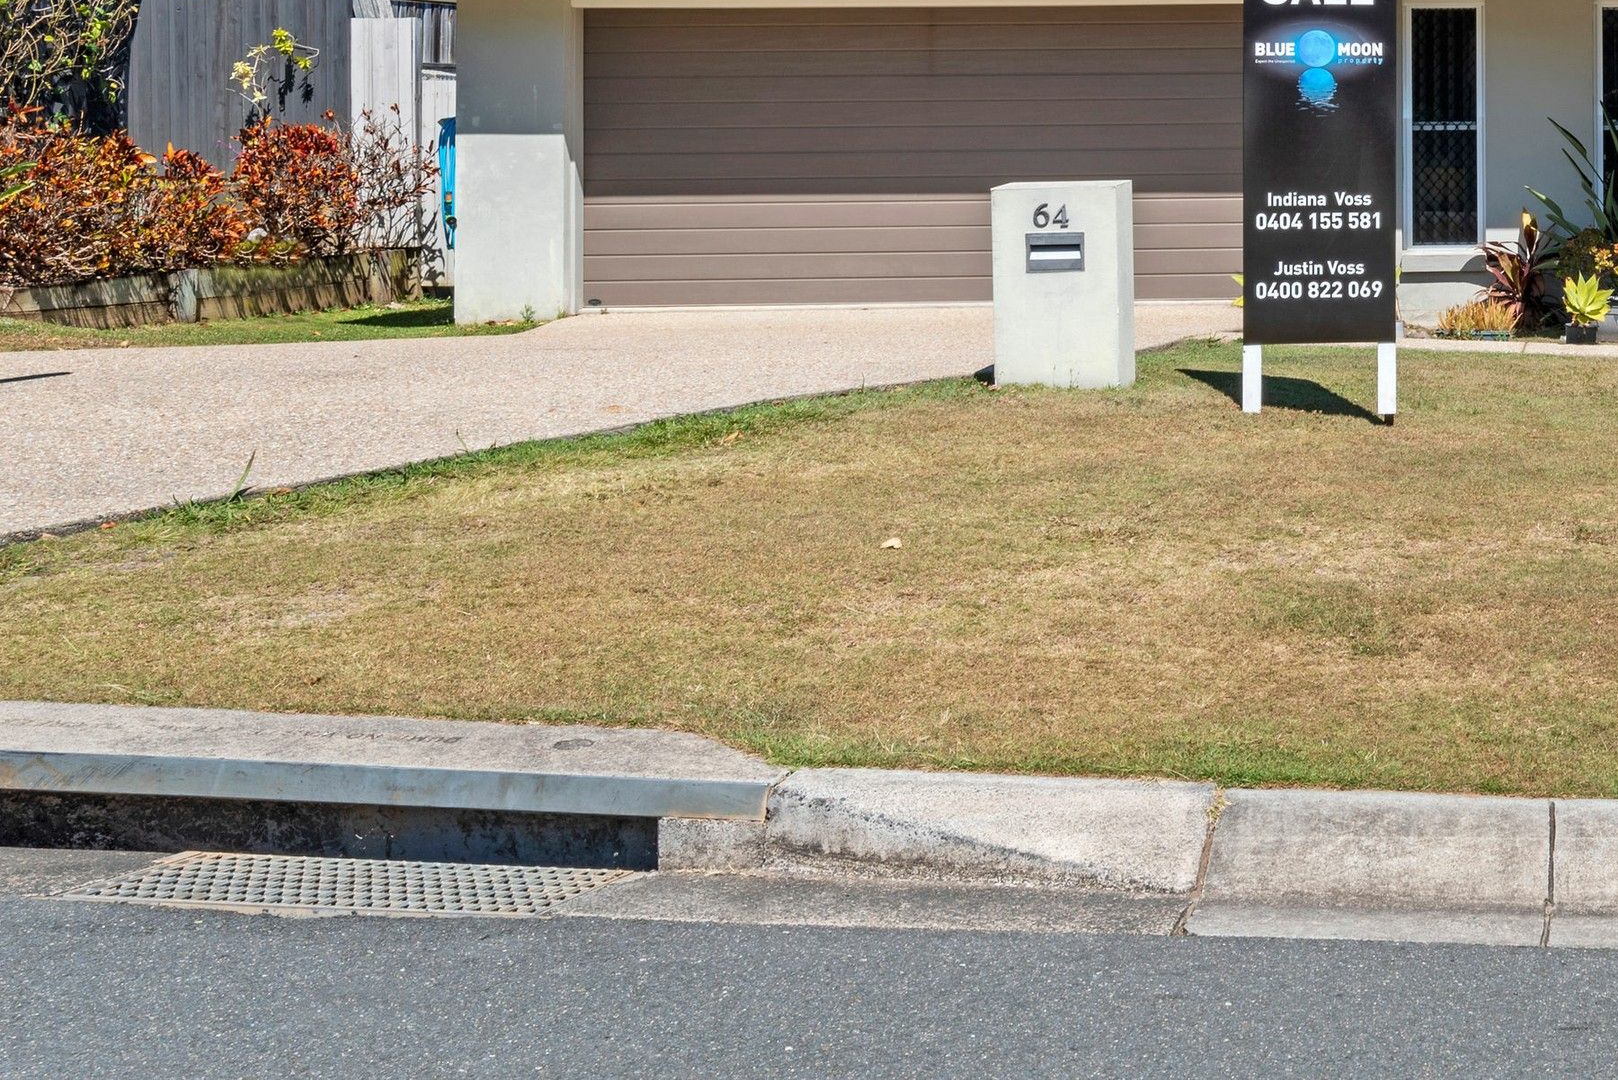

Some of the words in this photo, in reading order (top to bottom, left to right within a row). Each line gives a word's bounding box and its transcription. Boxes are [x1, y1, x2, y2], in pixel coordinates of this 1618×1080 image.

[1254, 41, 1296, 57] BLUE
[1337, 41, 1383, 57] MOON
[1266, 191, 1327, 207] Indiana
[1333, 191, 1373, 206] Voss
[1032, 202, 1070, 230] 64
[1255, 212, 1303, 231] 0404
[1308, 211, 1344, 230] 155
[1347, 210, 1382, 230] 581
[1273, 260, 1324, 276] Justin
[1326, 259, 1365, 275] Voss
[1255, 281, 1303, 300] 0400
[1307, 280, 1343, 299] 822
[1347, 279, 1383, 298] 069
